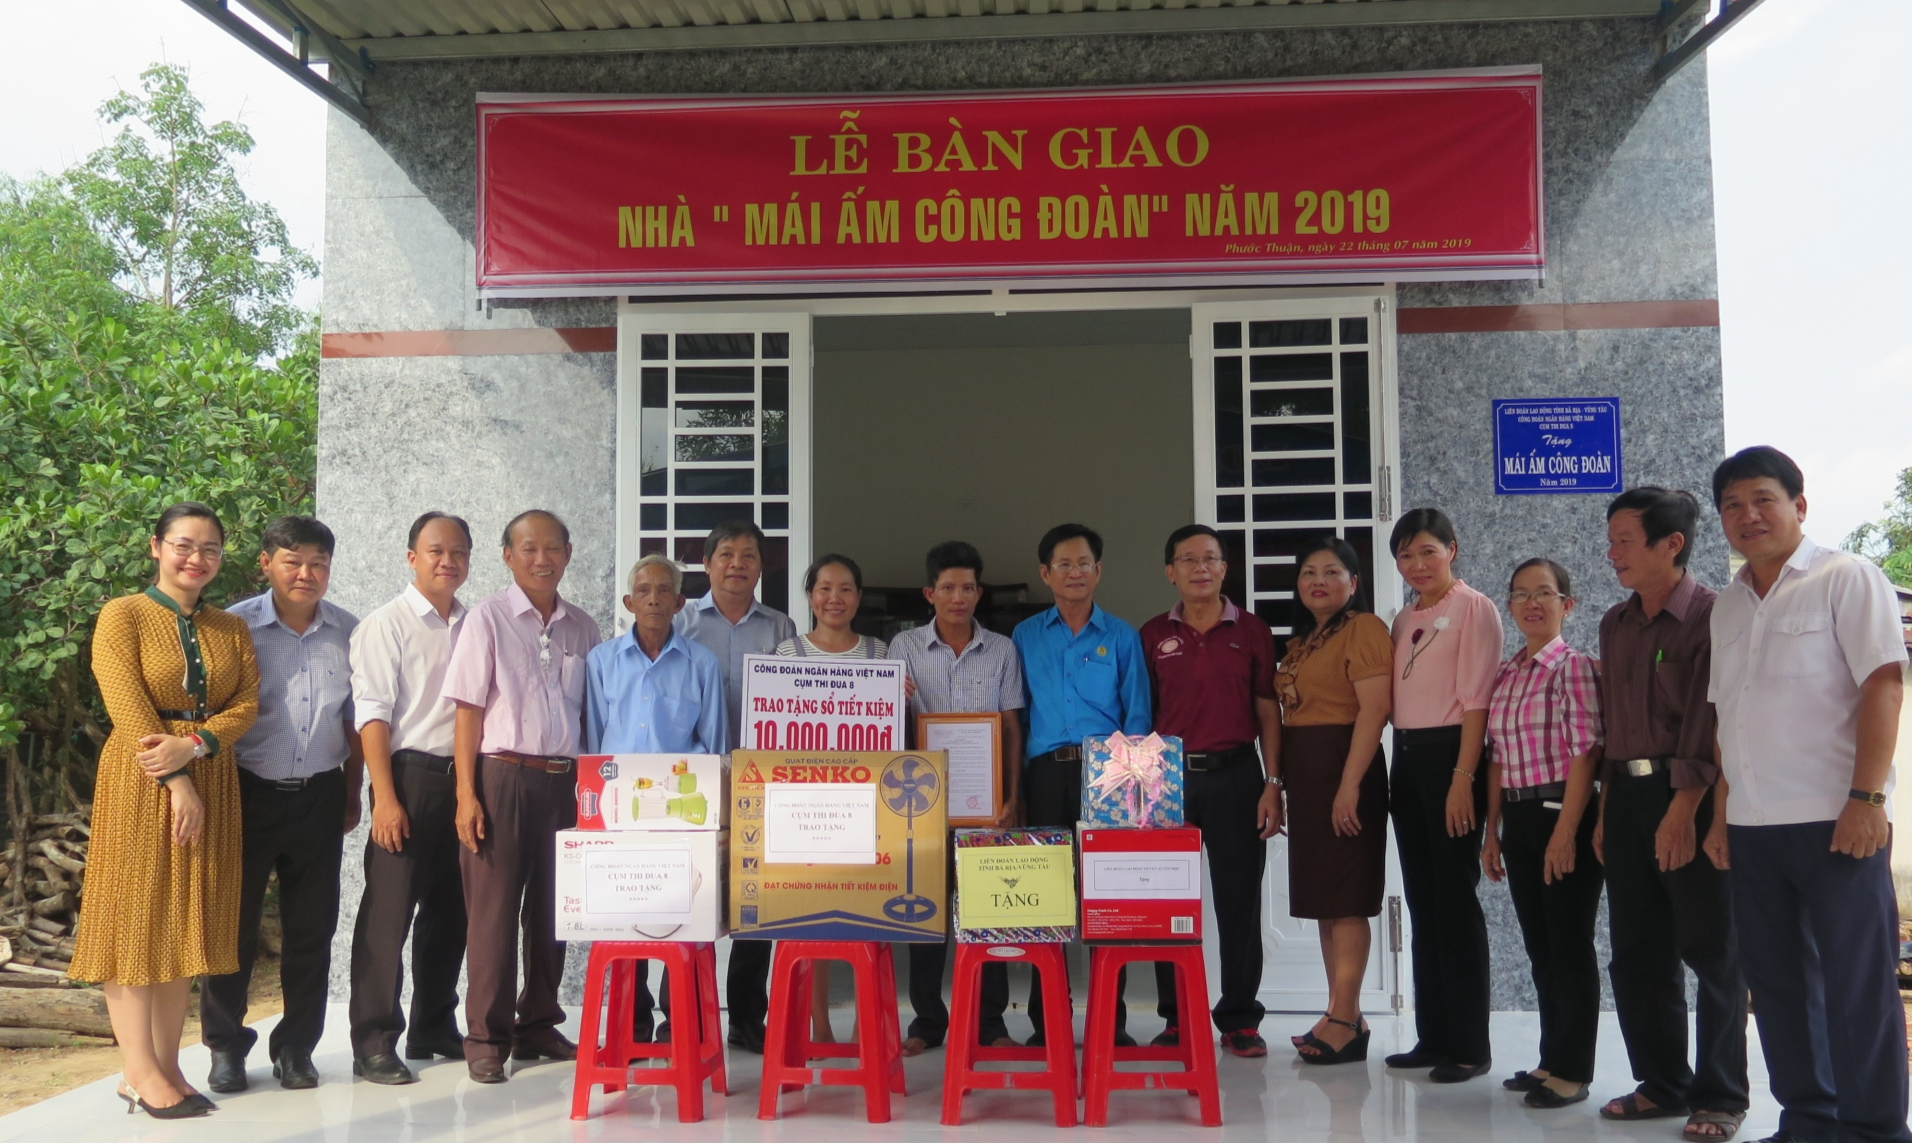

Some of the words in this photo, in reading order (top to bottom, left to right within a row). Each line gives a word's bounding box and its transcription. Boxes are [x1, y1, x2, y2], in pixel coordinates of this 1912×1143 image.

[789, 110, 868, 176] LỄ
[892, 117, 1029, 173] BÀN
[1048, 124, 1210, 170] GIAO
[618, 194, 695, 248] NHÀ
[744, 191, 820, 246] MÁI
[836, 186, 899, 244] ẤM
[915, 189, 1020, 243] CÔNG
[1036, 184, 1168, 240] ĐOÀN"
[1185, 184, 1279, 237] NĂM
[1295, 188, 1391, 234] 2019
[1225, 242, 1261, 254] Phước
[1265, 242, 1304, 255] Thuận,
[1308, 241, 1335, 255] ngày
[1339, 241, 1354, 251] 22
[1357, 240, 1391, 253] tháng
[1394, 239, 1409, 250] 07
[1412, 239, 1438, 249] năm
[1442, 238, 1472, 249] 2019
[1542, 434, 1572, 448] Tặng
[1504, 452, 1526, 474] MÁI
[1528, 448, 1545, 474] ẤM
[1548, 451, 1578, 474] CÔNG
[1581, 450, 1611, 473] ĐOÀN
[754, 663, 778, 674] CÔNG
[779, 664, 803, 675] ĐOÀN
[804, 665, 828, 676] NGÂN
[830, 666, 853, 677] HÀNG
[856, 668, 874, 679] VIỆT
[876, 669, 895, 678] NAM
[794, 678, 812, 690] CỤM
[816, 680, 828, 688] THI
[830, 680, 847, 689] ĐUA
[849, 681, 854, 689] 8
[753, 697, 784, 713] TRAO
[787, 695, 818, 717] TẶNG
[820, 691, 835, 715] SỔ
[837, 694, 863, 716] TIẾT
[865, 697, 894, 720] KIỆM
[754, 720, 893, 751] 10.000.000đ
[602, 766, 611, 777] 12
[771, 765, 872, 783] SENKO
[791, 812, 810, 820] CỤM
[823, 824, 846, 832] TẶNG
[608, 873, 627, 881] CỤM
[639, 884, 662, 893] TẶNG
[764, 882, 780, 891] ĐẠT
[782, 880, 812, 890] CHỨNG
[815, 881, 838, 892] NHẬN
[841, 880, 855, 890] TIẾT
[857, 881, 877, 892] KIỆM
[879, 882, 898, 892] ĐIỆN
[564, 896, 582, 904] Tas
[990, 891, 1039, 909] TẶNG
